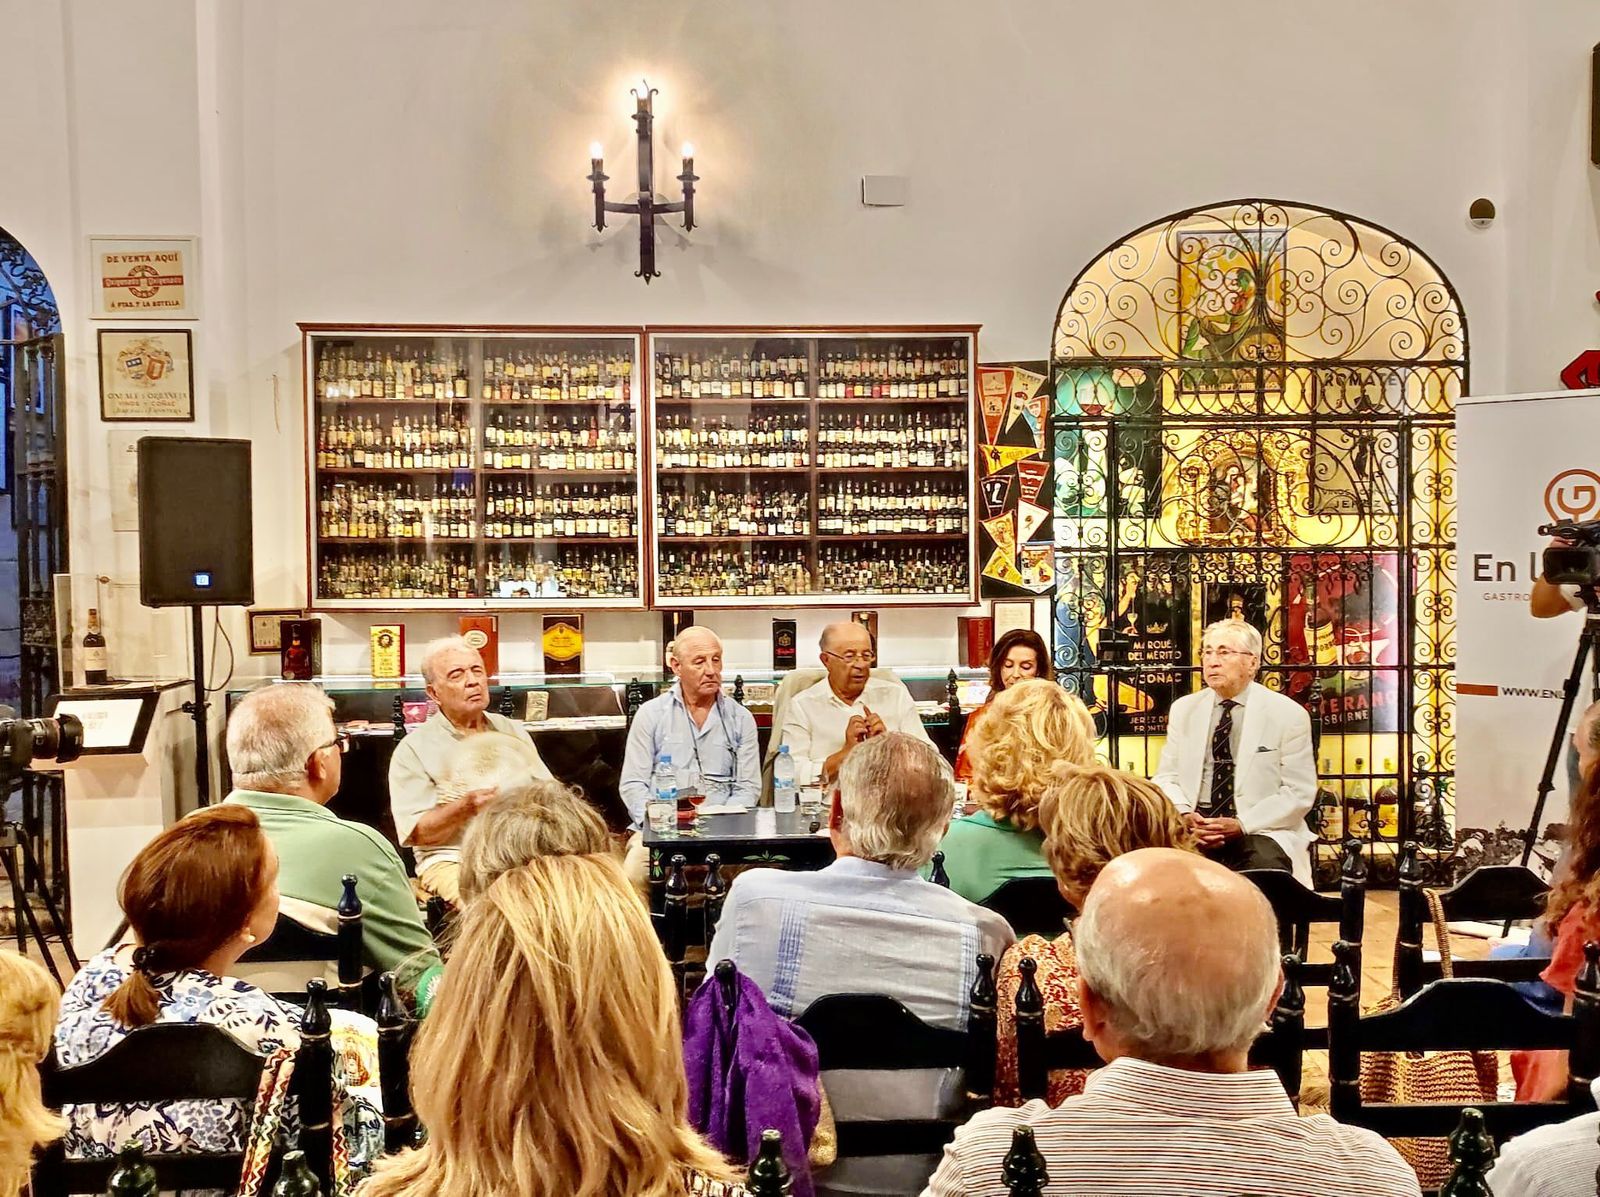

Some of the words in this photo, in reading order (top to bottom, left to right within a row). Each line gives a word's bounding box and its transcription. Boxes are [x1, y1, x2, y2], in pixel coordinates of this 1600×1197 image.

[121, 255, 151, 263] VENTA
[155, 253, 178, 263] AQUÍ
[1325, 372, 1398, 386] ROMATE
[1473, 553, 1516, 582] En
[1483, 593, 1531, 601] GASTRO
[1127, 652, 1145, 661] DEL
[1128, 676, 1136, 684] Y
[1138, 673, 1182, 684] COÑAC
